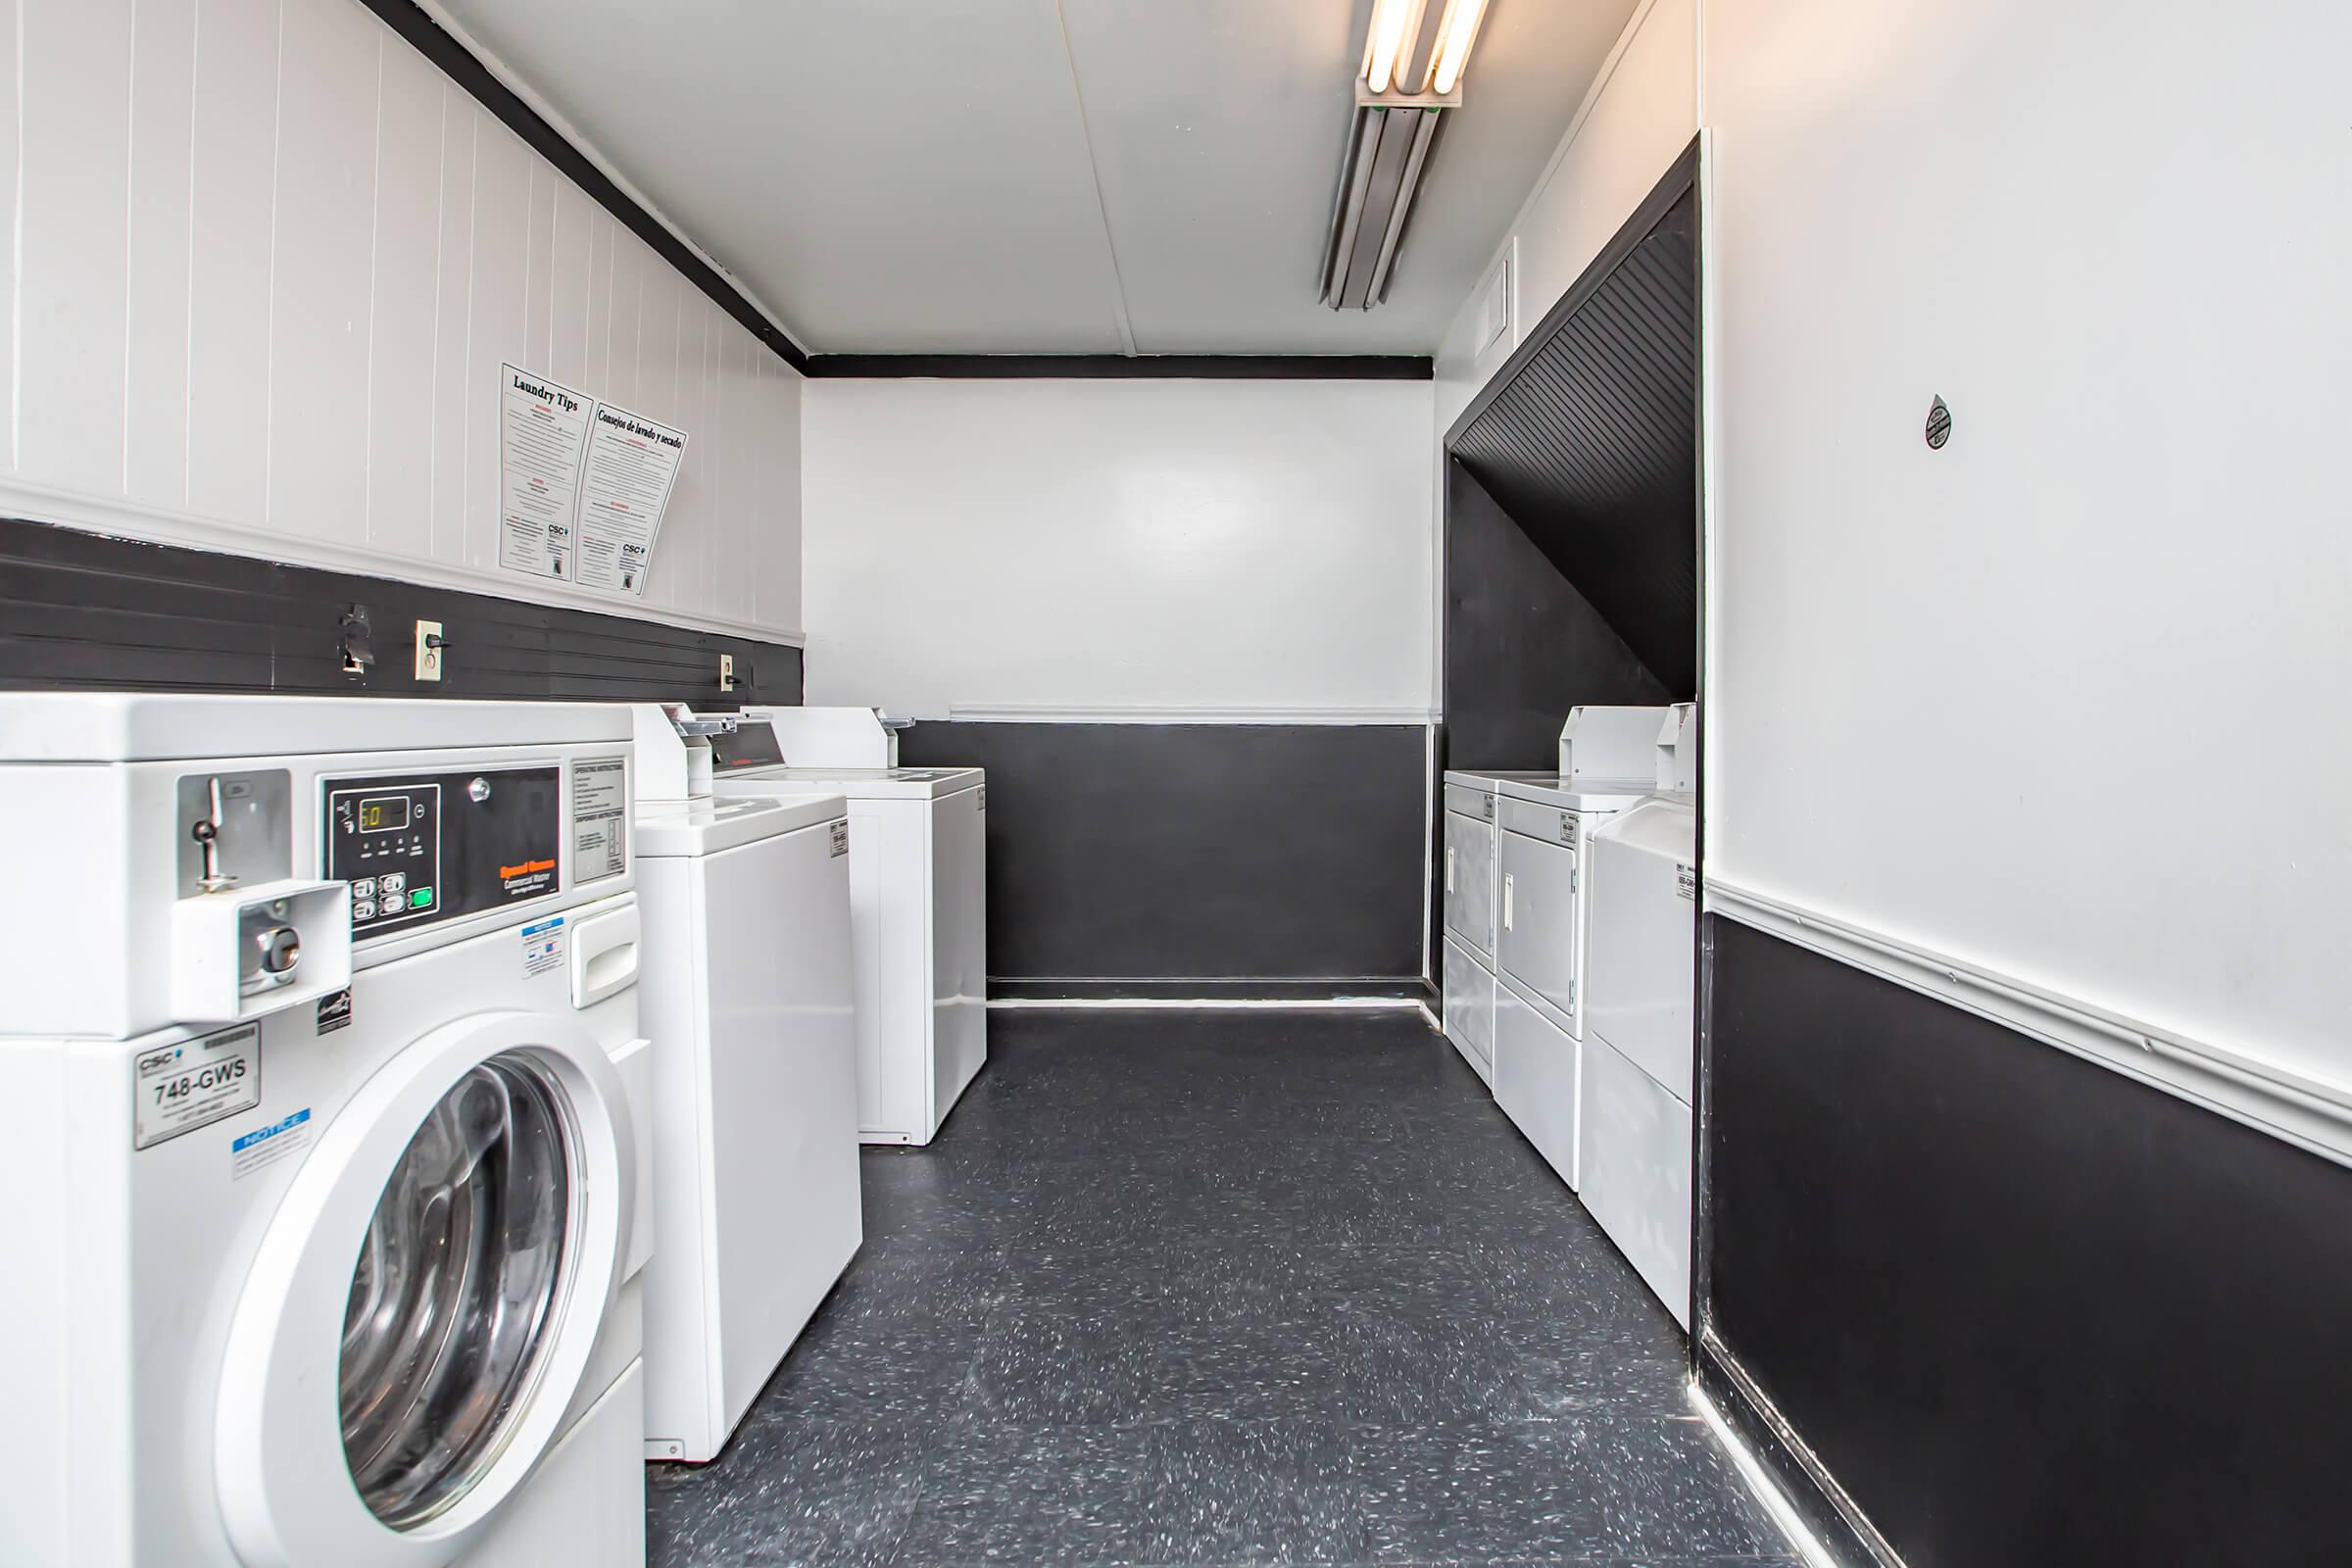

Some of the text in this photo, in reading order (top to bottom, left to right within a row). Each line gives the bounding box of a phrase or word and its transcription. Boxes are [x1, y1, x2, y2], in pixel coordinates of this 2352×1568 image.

[514, 374, 578, 412] Laundry Tips
[598, 410, 682, 449] Consejos de lavado y secado
[548, 524, 564, 535] CSC
[622, 544, 640, 554] CSC
[140, 1053, 172, 1071] CSC
[155, 1058, 247, 1105] 748-GWS
[243, 1114, 302, 1146] NOTICE
